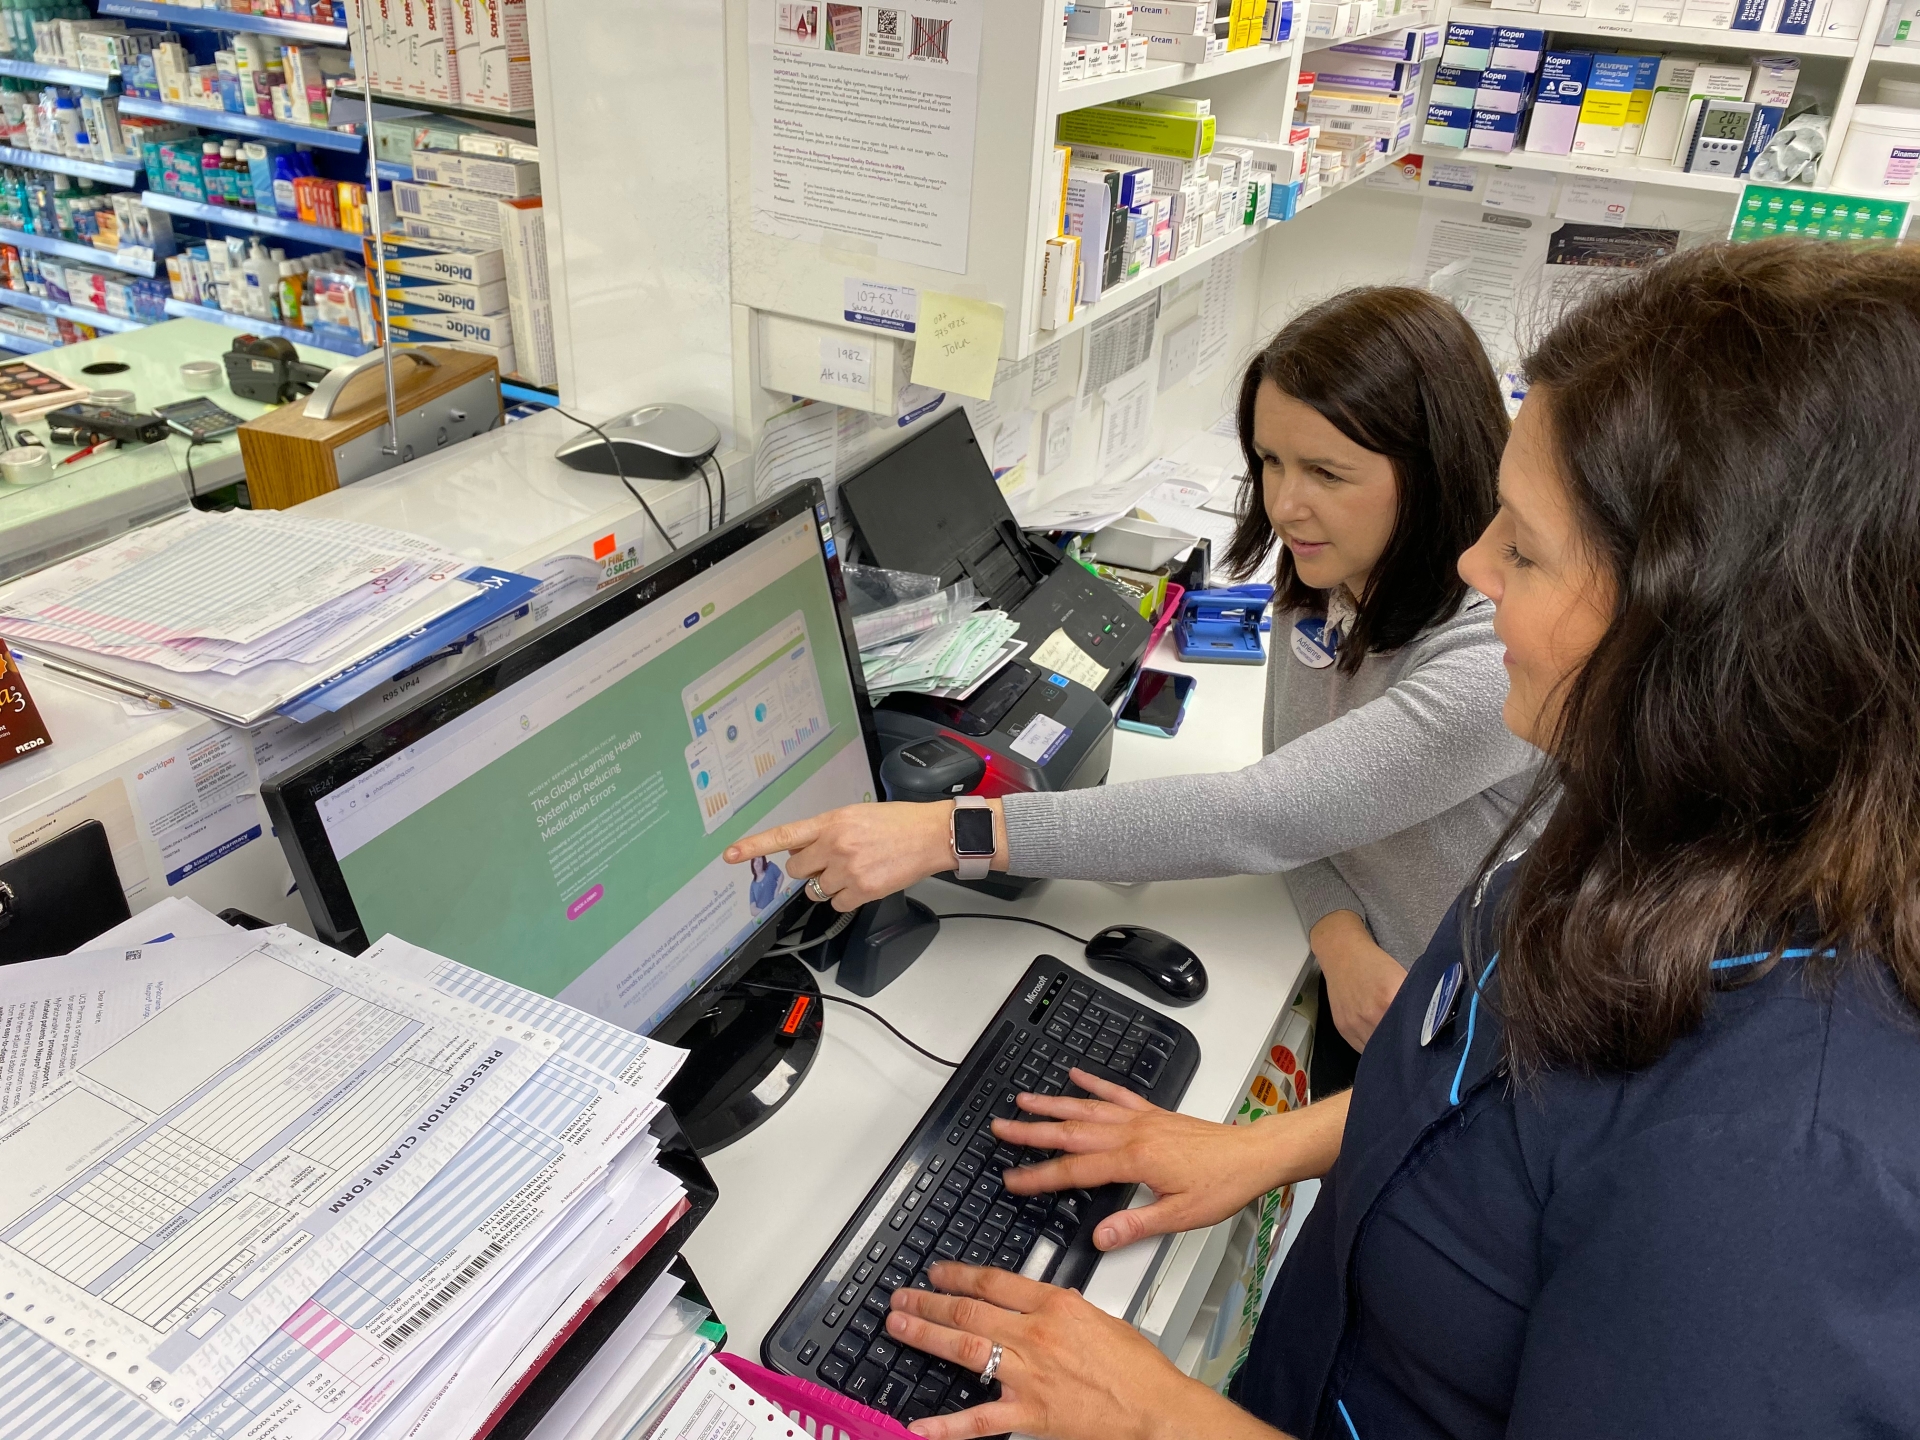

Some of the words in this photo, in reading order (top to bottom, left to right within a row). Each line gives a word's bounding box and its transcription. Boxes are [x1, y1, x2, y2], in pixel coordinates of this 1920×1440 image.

[1140, 6, 1162, 15] Cream
[1150, 35, 1172, 44] Cream
[1450, 26, 1474, 36] Kopen
[1500, 29, 1525, 38] Kopen
[1546, 56, 1571, 65] Kopen
[1438, 67, 1460, 76] Kopen
[1483, 71, 1506, 80] Kopen
[1595, 69, 1629, 77] 250mg/5ml
[1429, 107, 1452, 116] Kopen
[1476, 111, 1500, 120] Kopen
[1720, 126, 1737, 139] 55
[1893, 150, 1920, 159] Pinamox
[434, 262, 473, 280] Diclac
[437, 292, 475, 310] Diclac
[446, 320, 491, 342] Diclac
[614, 557, 637, 574] SAFETY
[1297, 638, 1321, 660] Adrienne
[382, 689, 399, 703] R95
[400, 677, 421, 694] VP44
[15, 737, 45, 754] MEDA
[143, 756, 175, 776] worldpay
[531, 794, 550, 811] The
[550, 776, 579, 799] Global
[579, 750, 616, 780] Learning
[615, 730, 642, 754] Health
[536, 801, 569, 828] System
[569, 790, 582, 804] for
[582, 763, 622, 795] Reducing
[541, 803, 590, 842] Medication
[590, 783, 617, 806] Errors
[218, 834, 248, 853] pharmacy
[1178, 957, 1194, 973] Microsoft
[1024, 975, 1048, 1004] Microsoft
[417, 1049, 504, 1132] PRESCRIPTION
[567, 1112, 597, 1143] PHARMACY
[372, 1135, 417, 1176] CLAIM
[328, 1177, 373, 1214] FORM
[478, 1197, 516, 1233] BALLYHALE
[515, 1168, 549, 1199] PHARMACY
[548, 1152, 566, 1169] LIMIT
[484, 1225, 497, 1236] T/A
[496, 1198, 526, 1225] KISSANES
[525, 1169, 559, 1200] PHARMACY
[491, 1232, 501, 1240] 6A
[500, 1202, 532, 1232] CHESTNUT
[532, 1186, 552, 1203] DRIVE
[498, 1207, 538, 1244] BROOKFIELD
[419, 1266, 439, 1282] Invoice:
[216, 1275, 236, 1292] MONTH
[185, 1308, 200, 1320] YEAR
[365, 1310, 386, 1330] Account:
[386, 1298, 401, 1311] 12009
[370, 1324, 381, 1334] Ord
[381, 1314, 393, 1325] Date:
[376, 1324, 393, 1339] Route:
[307, 1373, 323, 1388] 20.29
[315, 1379, 332, 1394] 20.29
[323, 1387, 337, 1400] 0.00
[287, 1403, 304, 1416] VAT
[408, 1372, 460, 1438] WWW.UNITED-DRUG.COM
[247, 1413, 271, 1437] GOODS
[270, 1398, 295, 1417] VALUE
[682, 1416, 696, 1435] PHARMACY
